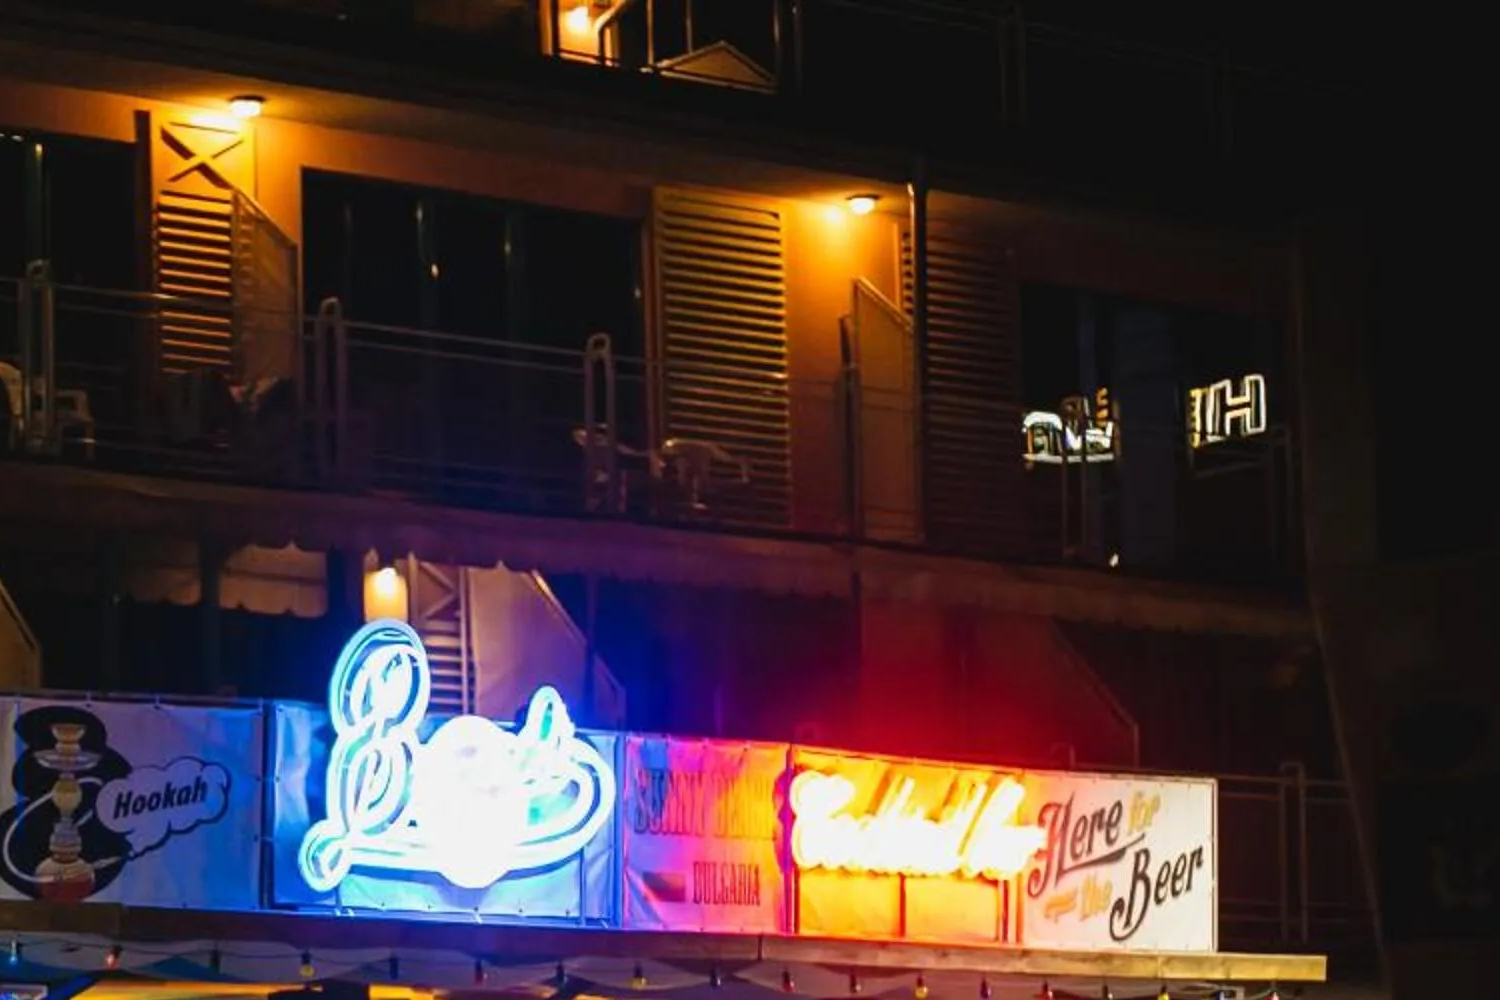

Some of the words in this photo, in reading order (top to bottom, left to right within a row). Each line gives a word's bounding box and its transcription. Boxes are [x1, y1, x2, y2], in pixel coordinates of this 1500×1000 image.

[112, 777, 209, 820] Hookah
[1027, 791, 1123, 899] Here
[692, 860, 761, 906] BULGARIA
[1109, 845, 1204, 942] Beer
